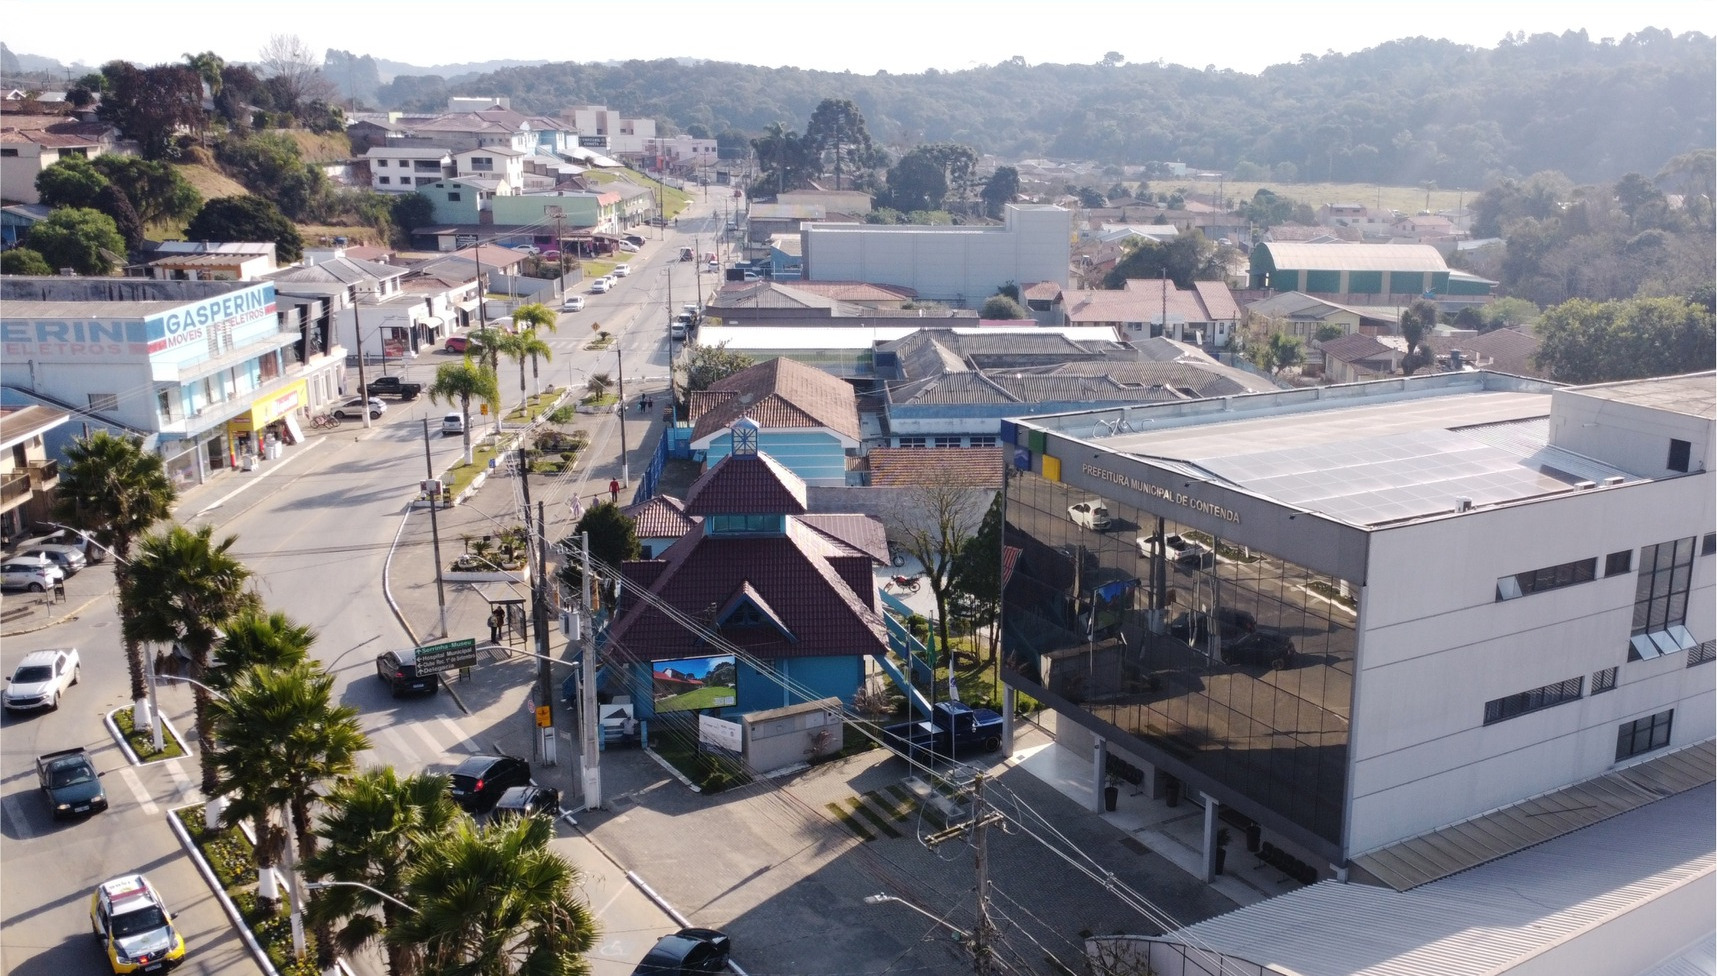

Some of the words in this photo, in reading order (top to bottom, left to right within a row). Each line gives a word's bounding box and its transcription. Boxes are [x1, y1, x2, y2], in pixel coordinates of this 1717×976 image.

[166, 289, 261, 334] GASPERIN
[6, 343, 121, 356] ELETROS
[1082, 463, 1130, 488] PREFEITURA
[1130, 477, 1175, 503] MUNICIPAL
[1176, 493, 1189, 507] DE
[1189, 498, 1240, 524] CONTENDA
[422, 652, 445, 661] Hospital
[446, 648, 472, 656] Municipal
[423, 664, 455, 673] Delegacia
